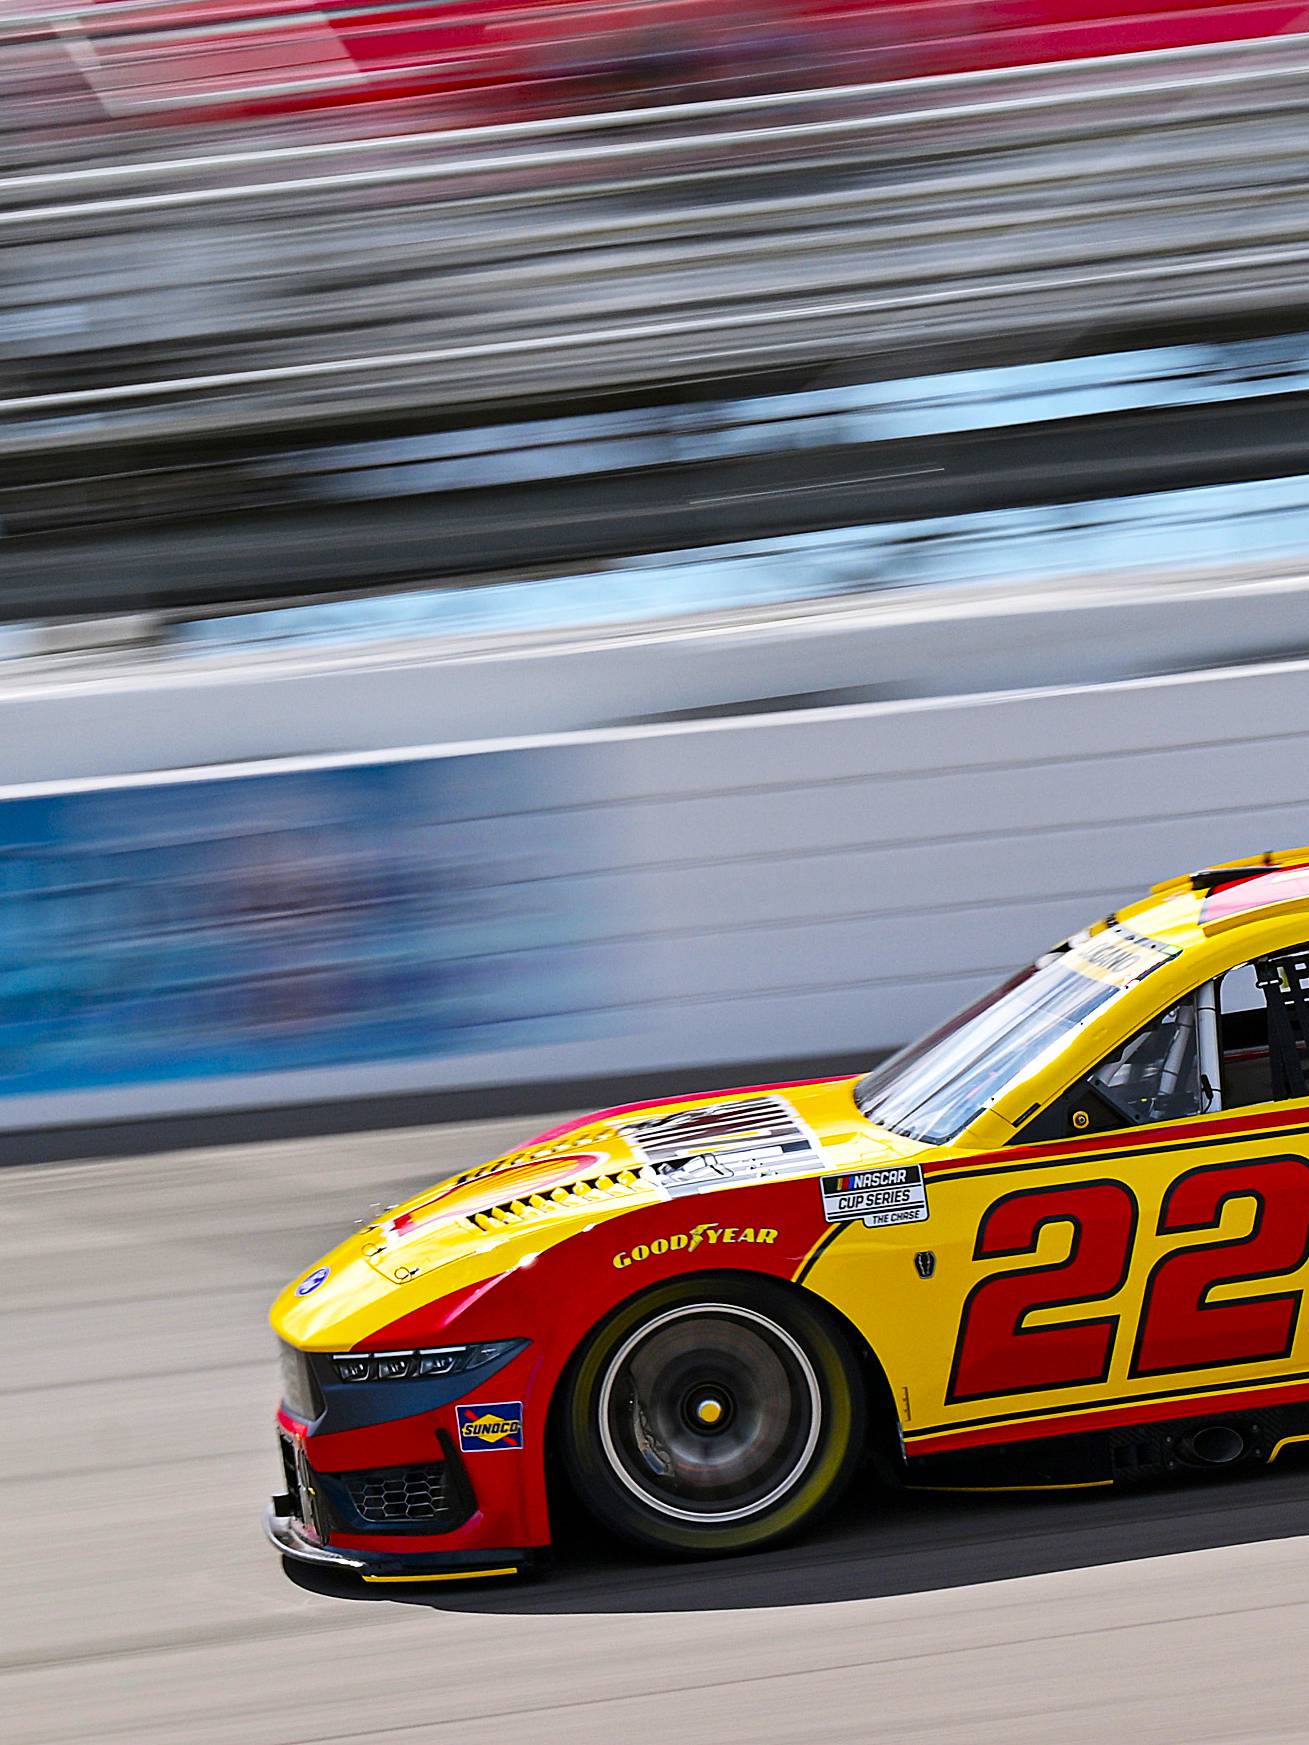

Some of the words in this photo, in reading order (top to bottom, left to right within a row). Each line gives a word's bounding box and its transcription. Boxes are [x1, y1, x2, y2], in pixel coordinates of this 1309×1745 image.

[853, 1169, 907, 1189] NASCAR
[838, 1195, 864, 1210] CUP
[865, 1189, 911, 1207] SERIES
[873, 1214, 890, 1225] THE
[890, 1210, 920, 1223] CHASE
[612, 1224, 778, 1268] GOODYEAR
[464, 1421, 519, 1436] SUNOCO
